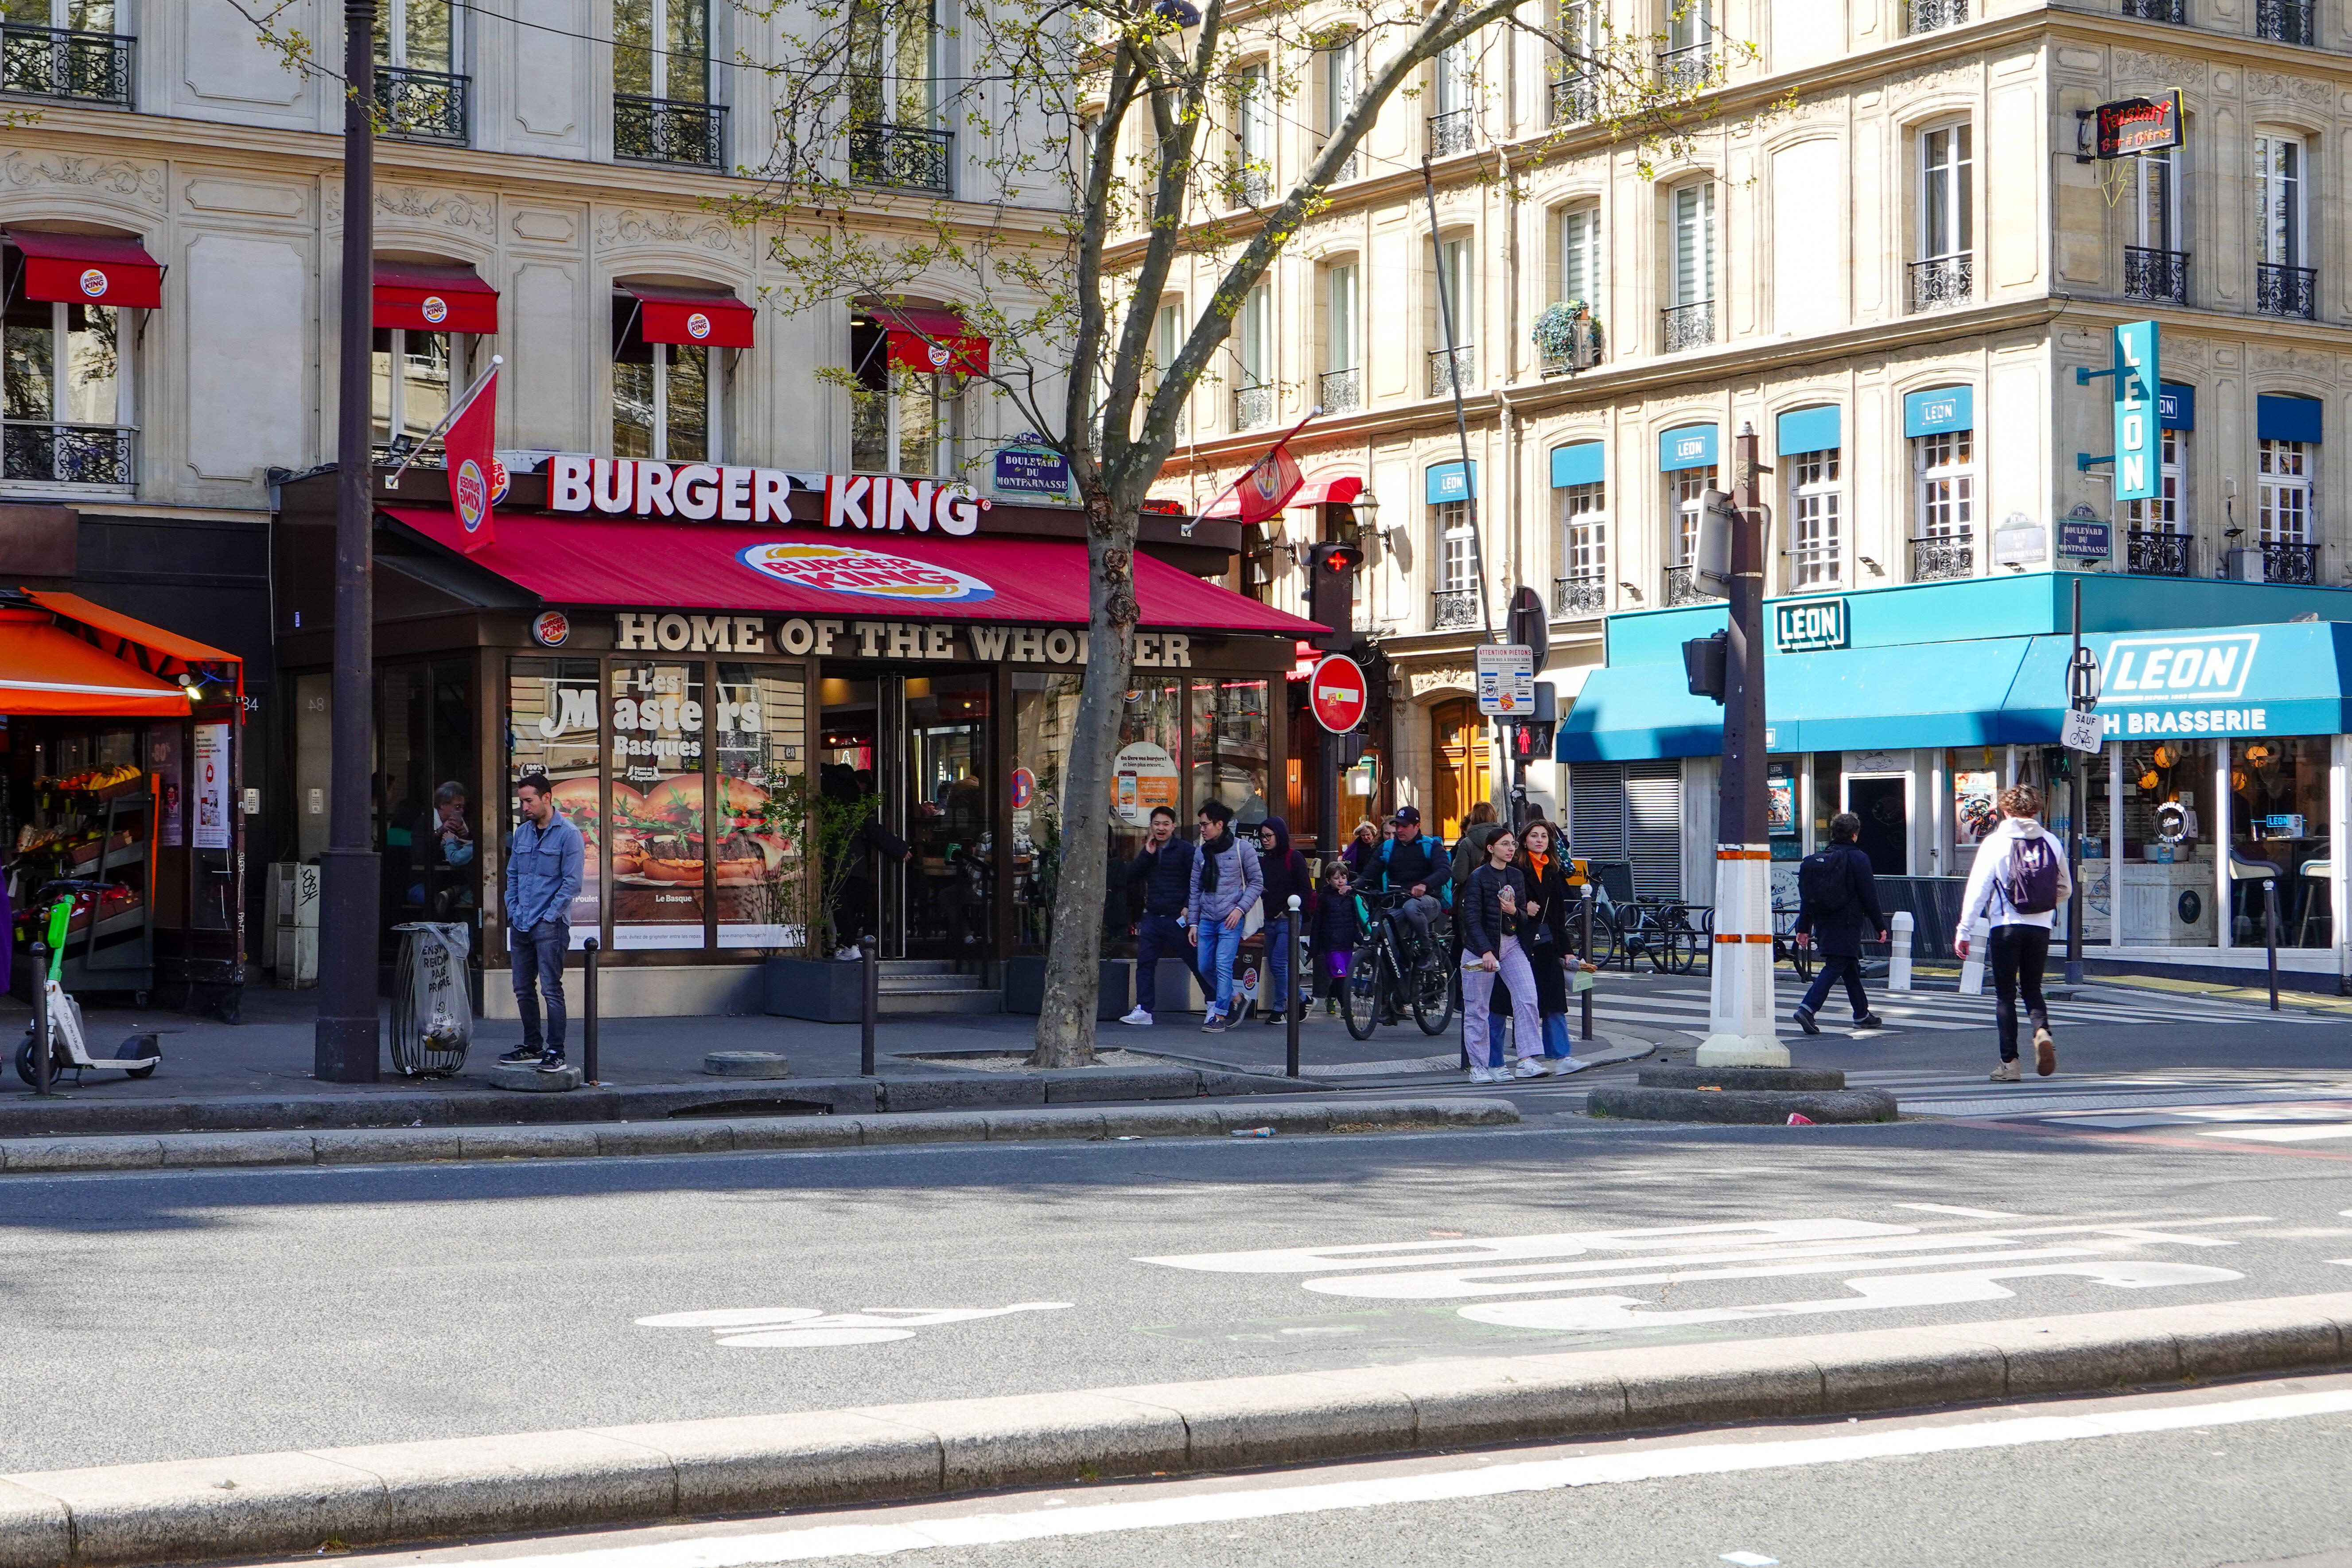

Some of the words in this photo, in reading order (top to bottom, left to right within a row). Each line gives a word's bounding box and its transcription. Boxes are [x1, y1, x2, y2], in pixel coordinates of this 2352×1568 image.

[2101, 138, 2124, 152] Bar
[85, 280, 104, 289] KING
[427, 306, 443, 316] KING
[692, 323, 707, 332] KING
[1006, 456, 1060, 467] BOULEVARD
[1026, 468, 1039, 476] DU
[997, 477, 1067, 489] MONTPARNASSE
[548, 456, 792, 523] BURGER
[823, 475, 978, 536] KING
[2064, 526, 2103, 535] BOULEVARD
[2059, 545, 2108, 553] MONTPARNASSE
[760, 558, 923, 574] BURGER
[793, 570, 960, 588] KING
[540, 617, 564, 631] BURGER
[542, 623, 566, 639] KING
[616, 613, 764, 654] HOME
[778, 618, 836, 655] OF
[851, 621, 954, 659] THE
[971, 626, 1192, 668] WHOER
[638, 669, 678, 692] Les
[2076, 714, 2096, 726] SAUF
[2128, 709, 2266, 734] BRASSERIE
[613, 735, 701, 760] Basques
[2158, 802, 2185, 813] MOULES
[2159, 833, 2183, 843] FRITES
[666, 895, 692, 904] Basque
[1245, 977, 1256, 985] KING
[435, 1013, 454, 1024] PARIS
